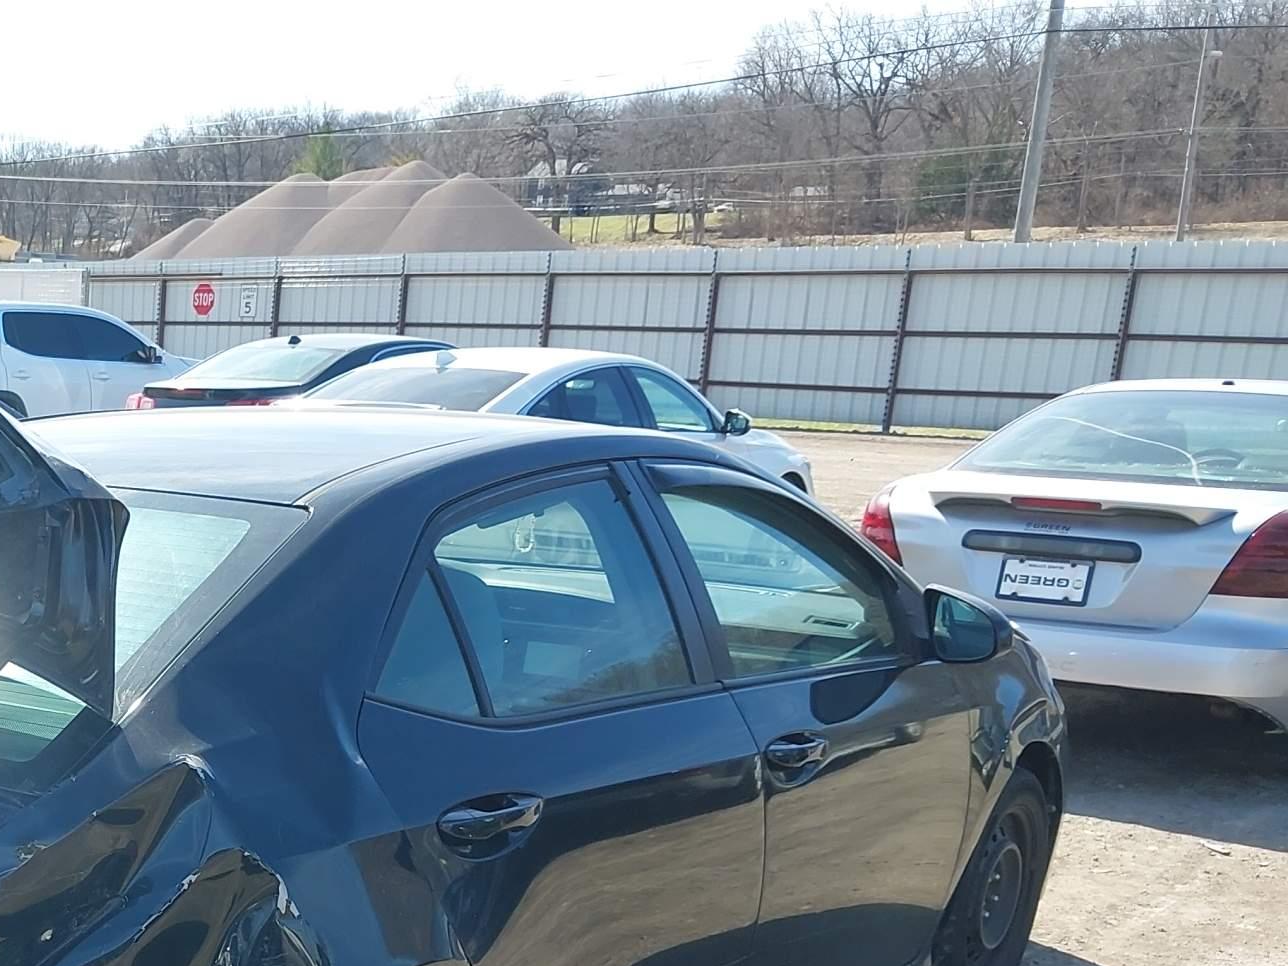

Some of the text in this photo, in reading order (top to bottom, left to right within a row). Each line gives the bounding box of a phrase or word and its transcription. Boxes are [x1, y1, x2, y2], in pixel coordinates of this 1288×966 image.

[194, 292, 214, 306] STOP
[244, 302, 252, 314] 5
[1033, 522, 1071, 531] GREEN
[1004, 573, 1070, 588] GREEN
